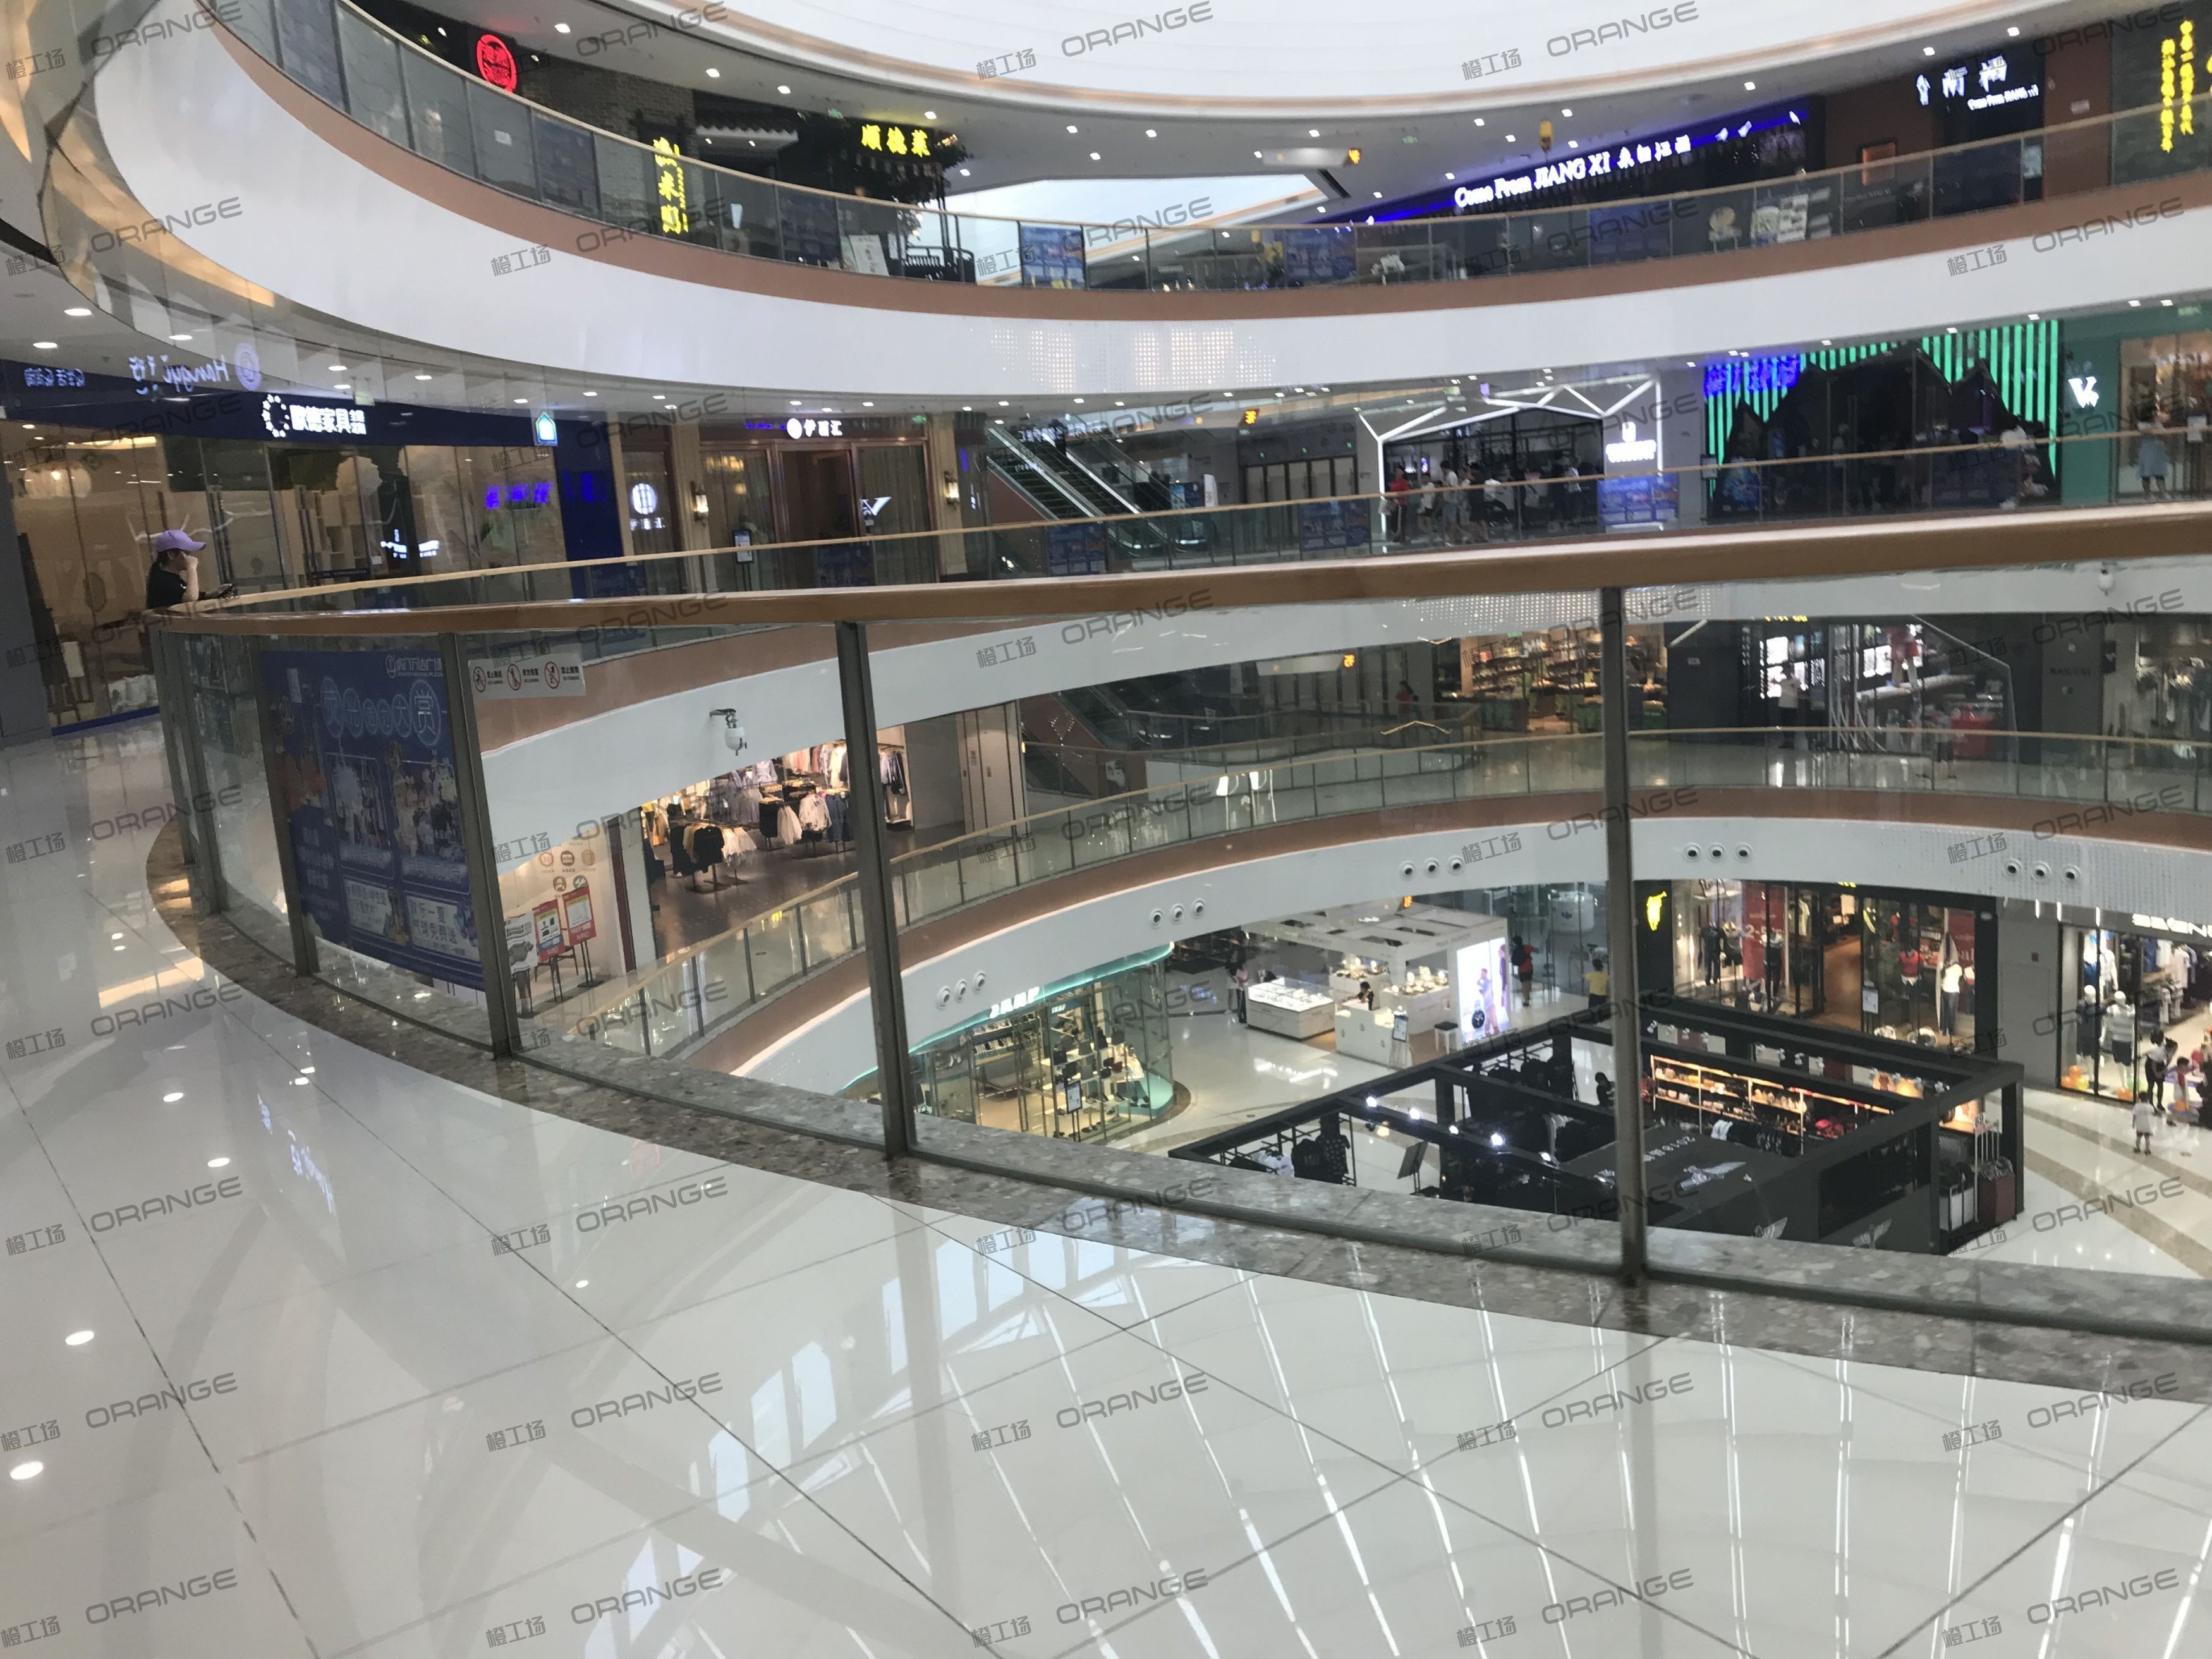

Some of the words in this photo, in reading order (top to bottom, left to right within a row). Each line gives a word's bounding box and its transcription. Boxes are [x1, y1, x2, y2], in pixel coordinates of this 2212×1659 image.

[1495, 176, 1532, 198] From
[1534, 158, 1586, 189] JIANG
[1588, 151, 1611, 176] XI
